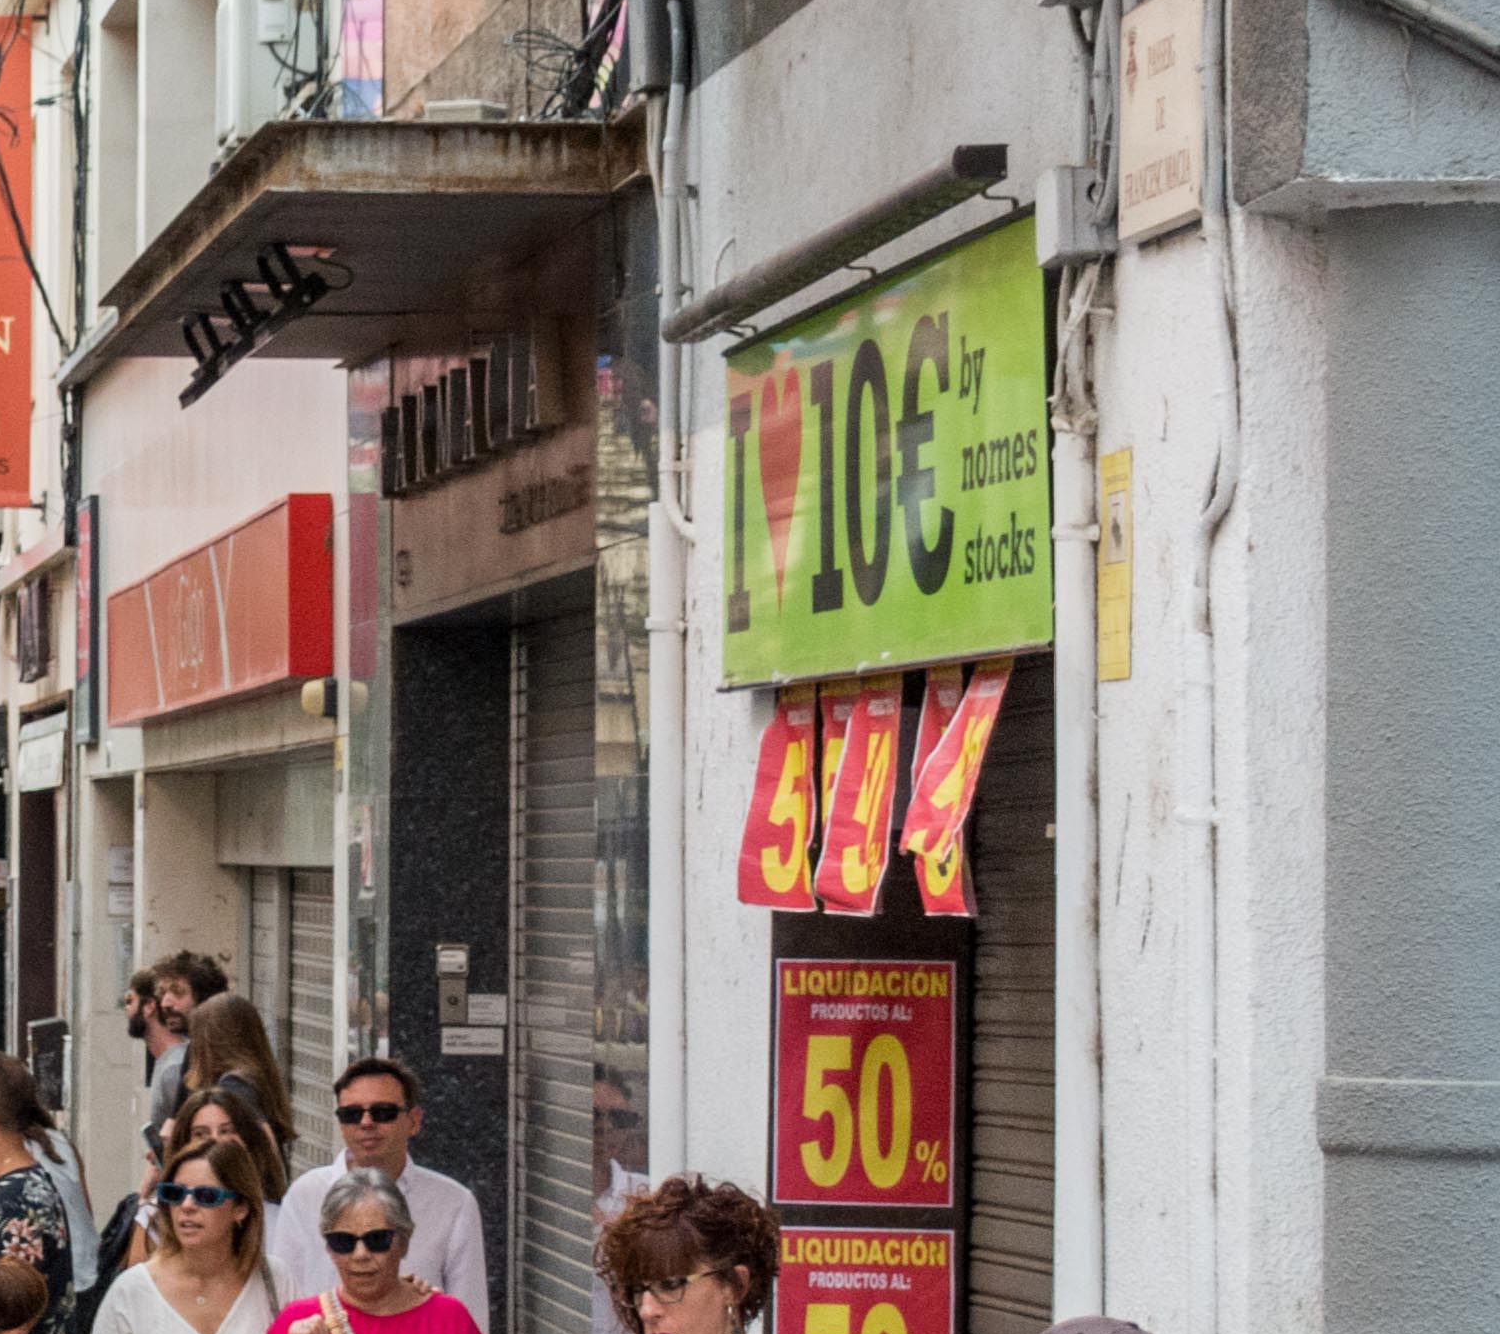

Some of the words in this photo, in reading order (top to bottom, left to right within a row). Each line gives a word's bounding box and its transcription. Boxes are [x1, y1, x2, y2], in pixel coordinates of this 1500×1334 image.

[726, 390, 755, 636] I
[809, 309, 956, 616] 10€
[957, 332, 987, 417] by
[960, 426, 1040, 493] nomes
[963, 510, 1037, 587] stocks
[783, 967, 948, 999] LIQUIDACIÓN
[810, 1002, 889, 1022] PRODUCTOS
[800, 1033, 913, 1189] 50
[781, 1234, 947, 1268] LIQUIDACIÓN
[808, 1272, 887, 1291] PRODUCTOS
